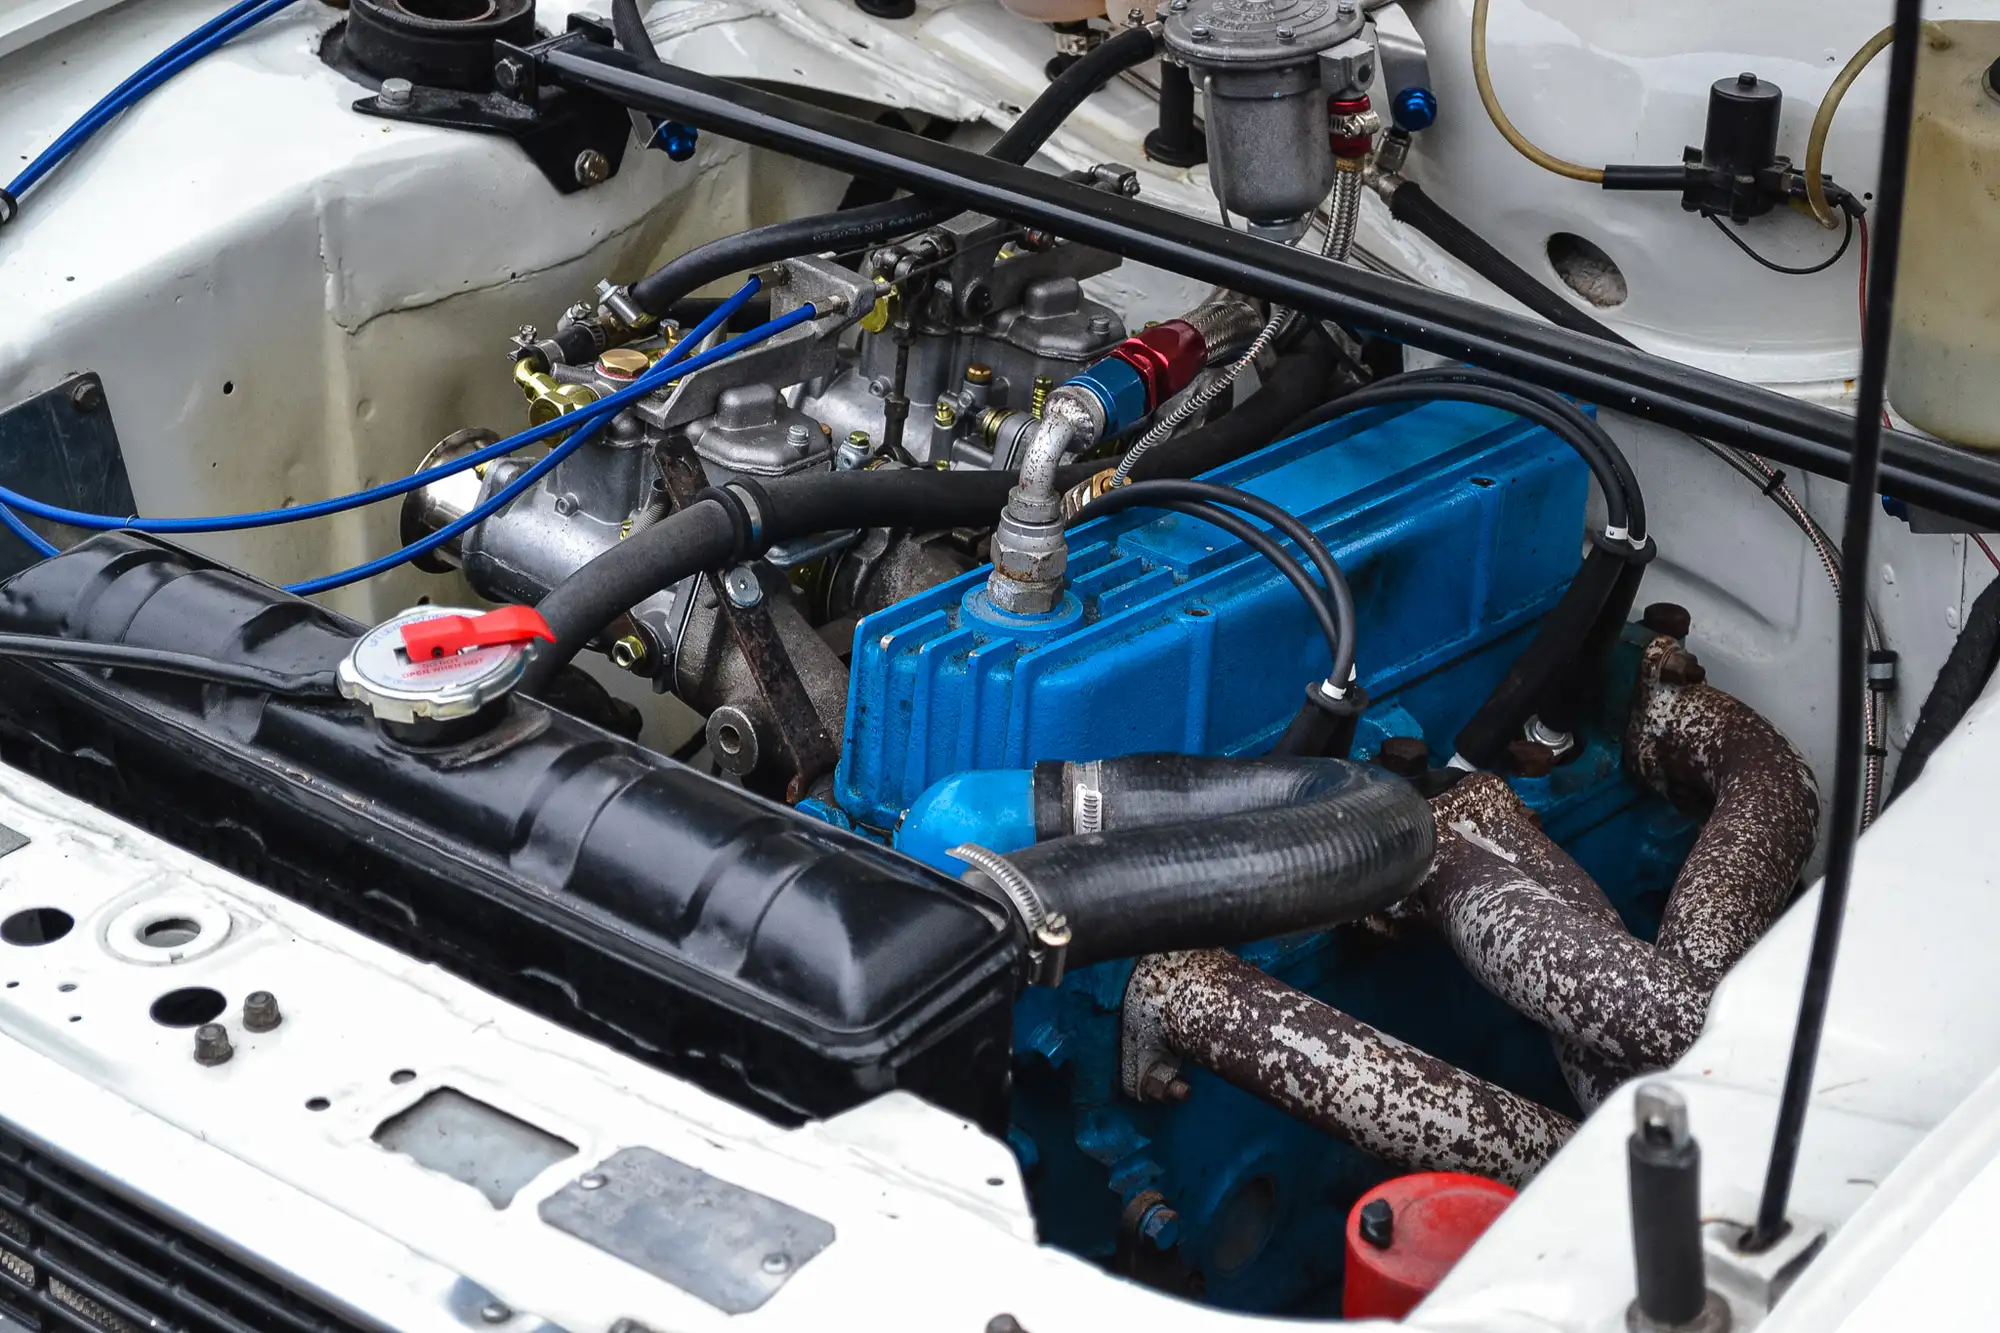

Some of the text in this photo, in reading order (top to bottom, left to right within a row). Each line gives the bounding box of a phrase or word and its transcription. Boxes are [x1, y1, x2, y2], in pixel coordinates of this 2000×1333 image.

[402, 657, 484, 679] OPEN WHEN HOT
